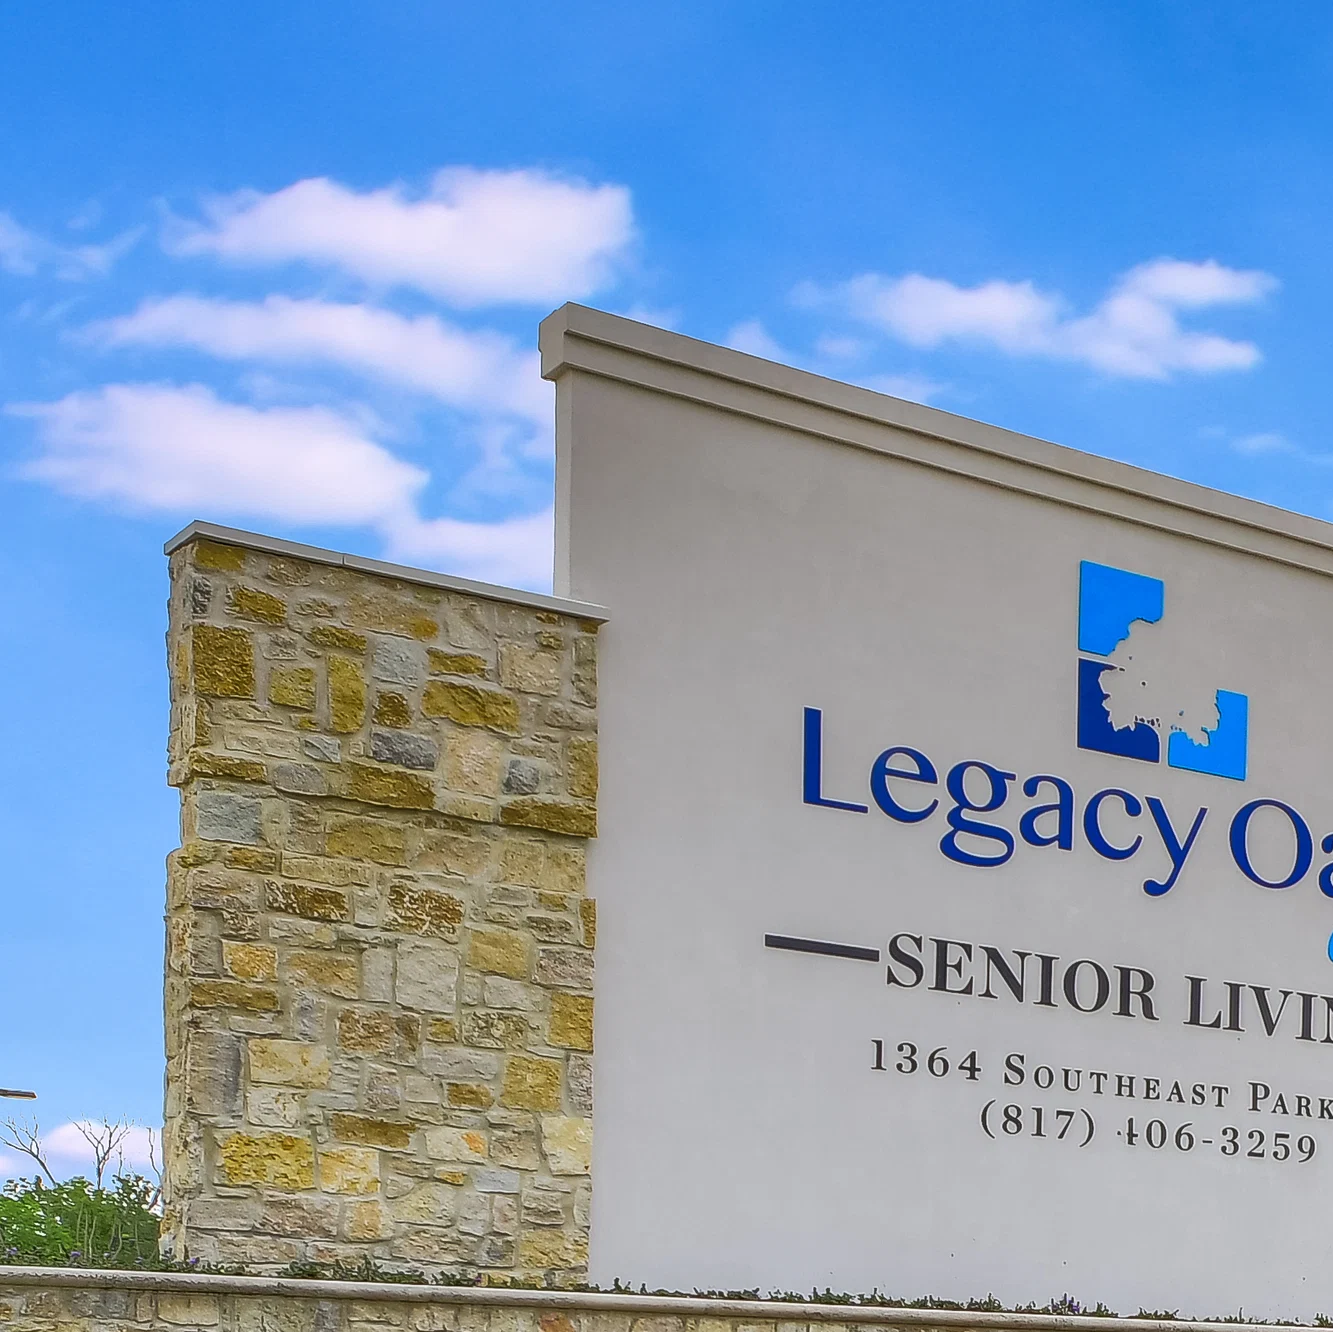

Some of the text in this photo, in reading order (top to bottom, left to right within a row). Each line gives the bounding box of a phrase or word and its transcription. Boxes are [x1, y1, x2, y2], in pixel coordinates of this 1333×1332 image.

[803, 705, 1208, 896] Legacy
[886, 932, 1160, 1021] SENIOR
[870, 1039, 982, 1081] 1364
[979, 1098, 1317, 1164] (817) 406-3259
